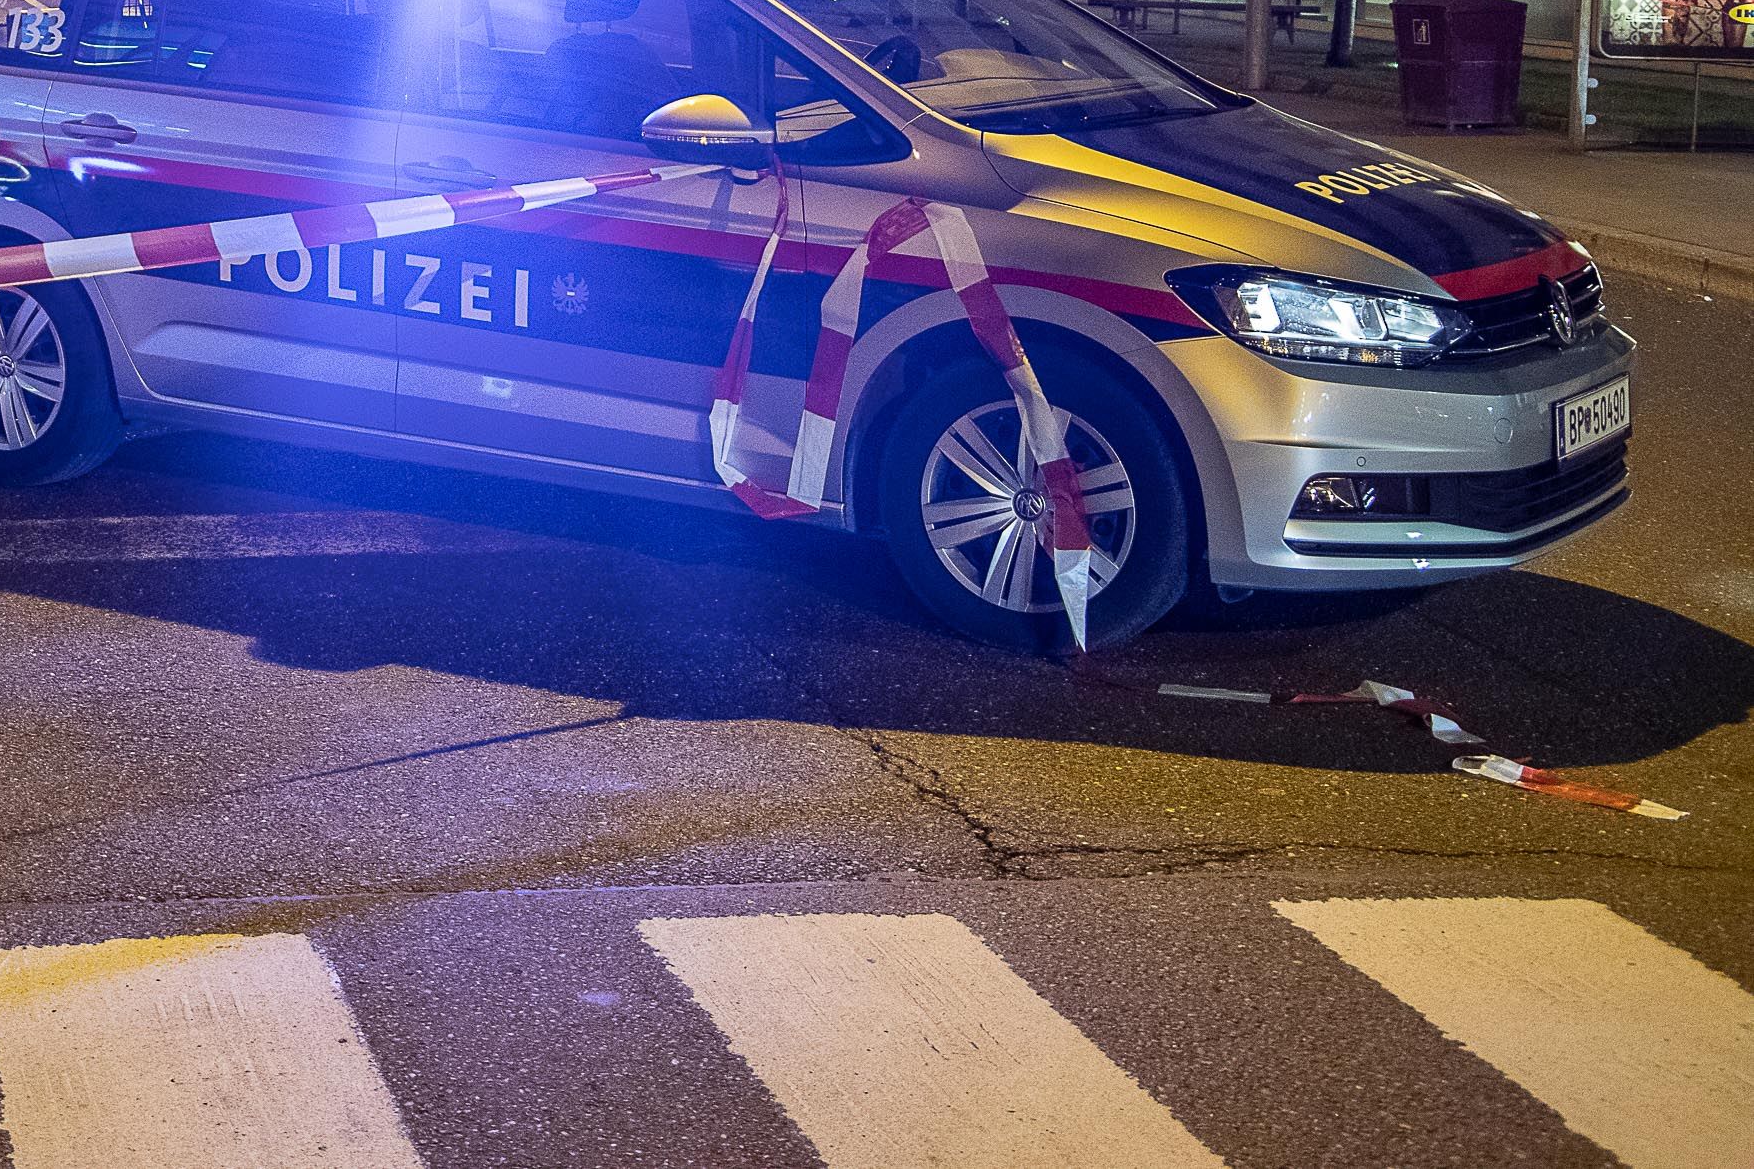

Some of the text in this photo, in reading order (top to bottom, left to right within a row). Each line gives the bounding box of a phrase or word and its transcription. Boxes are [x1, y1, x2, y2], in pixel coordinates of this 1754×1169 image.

[8, 7, 66, 53] 133
[1294, 162, 1441, 204] POLIZEI
[1569, 386, 1625, 445] BP 50490
